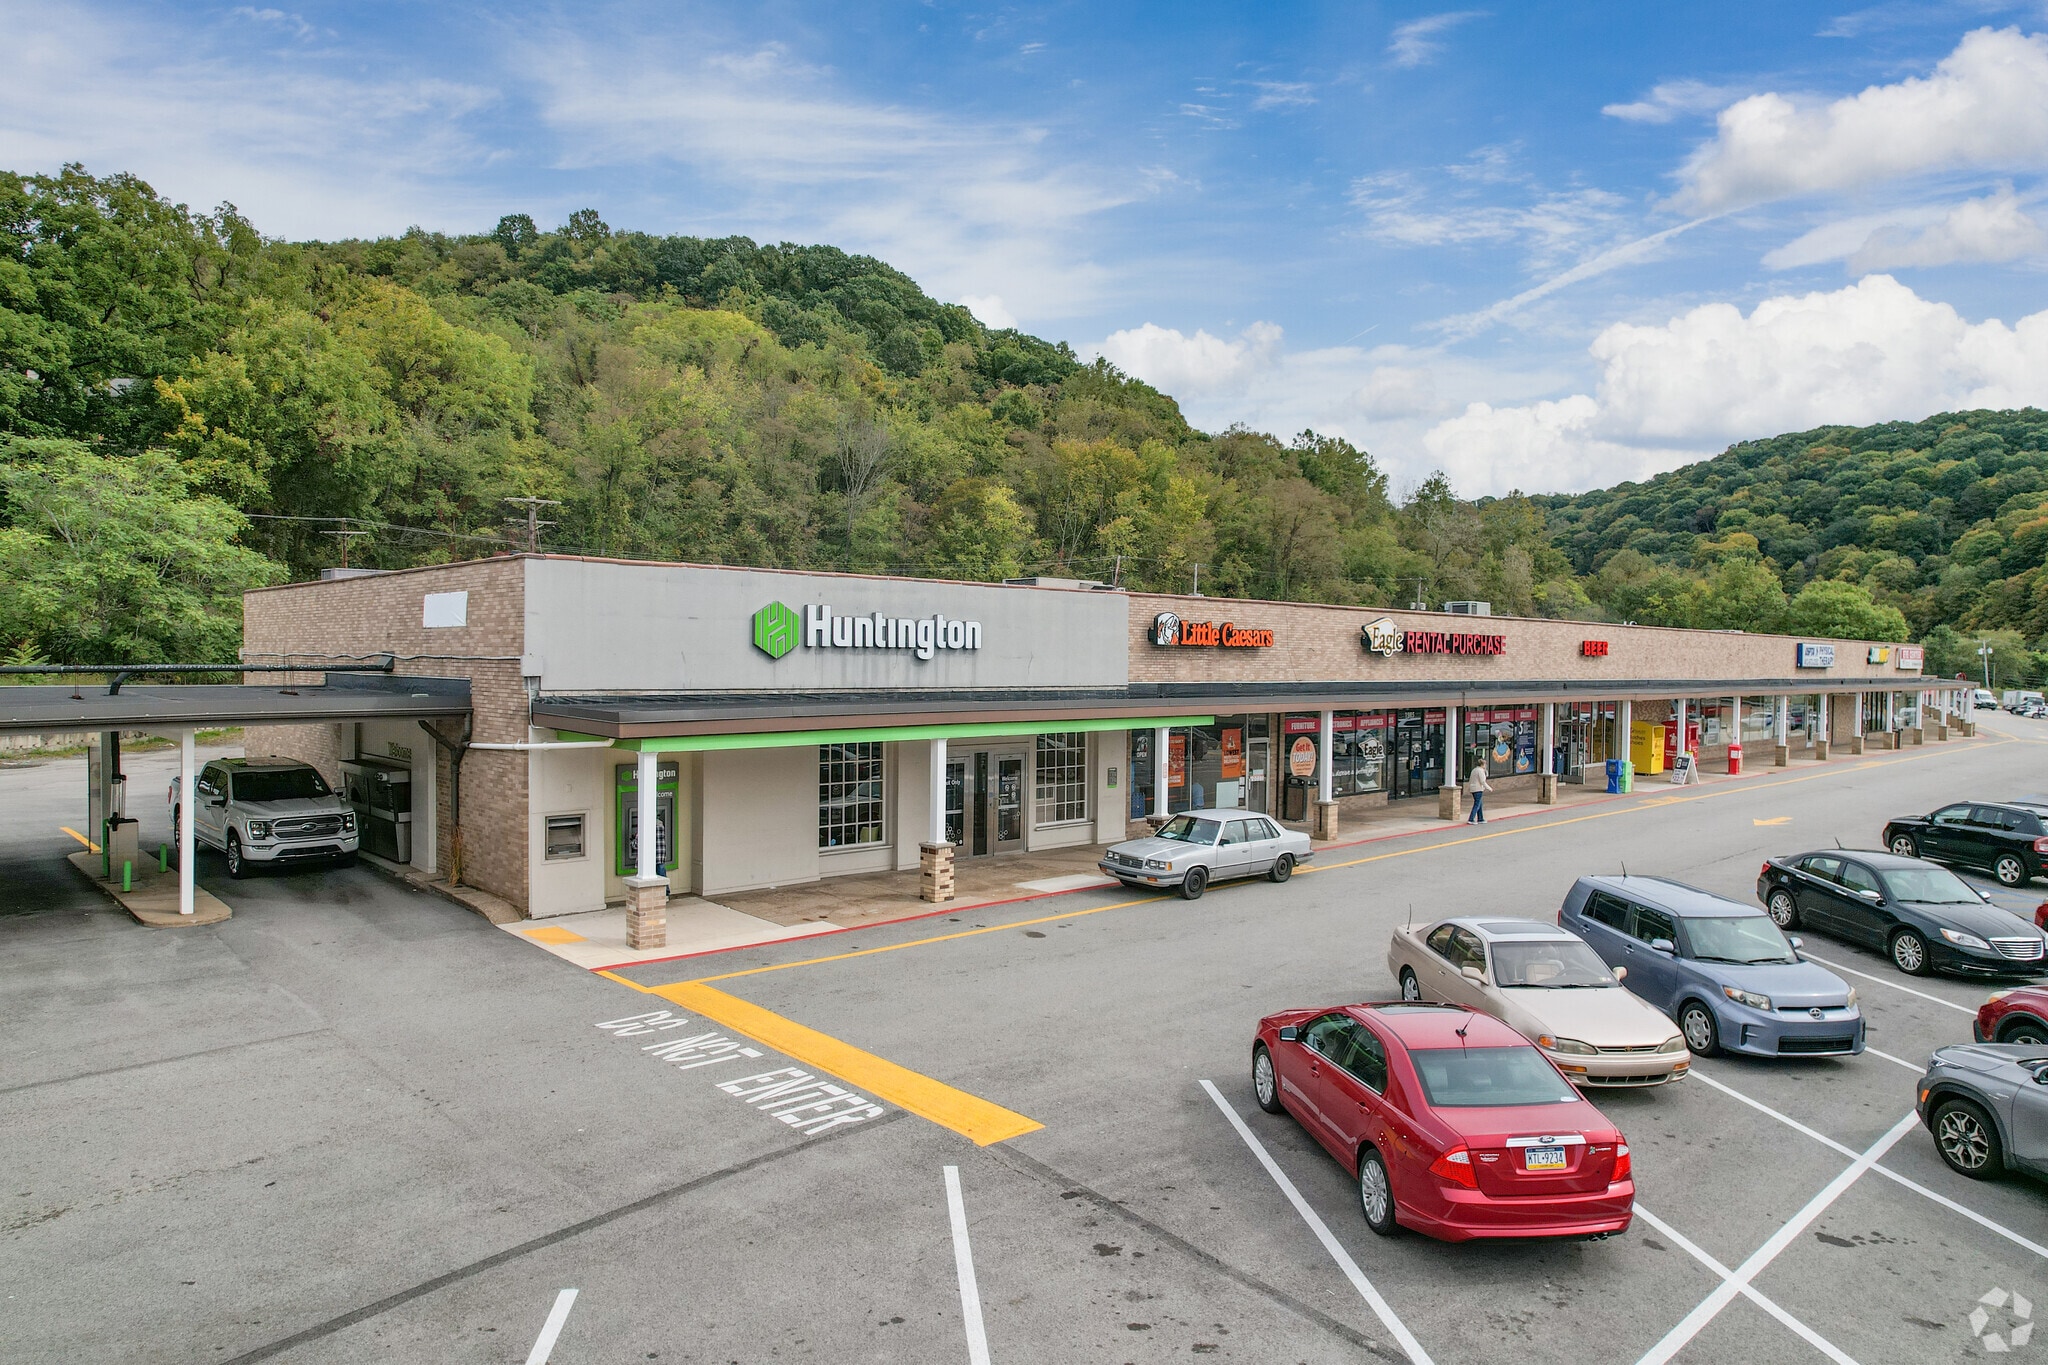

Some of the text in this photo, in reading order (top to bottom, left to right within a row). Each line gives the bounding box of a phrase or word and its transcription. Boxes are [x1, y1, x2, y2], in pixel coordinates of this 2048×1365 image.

[803, 603, 982, 660] Huntington
[1180, 620, 1274, 647] Little Caesars
[1372, 626, 1507, 657] Eagle RENTAL PURCHASE
[1583, 640, 1609, 656] BEER
[1291, 721, 1316, 730] FURNITURE
[1364, 742, 1383, 759] Eagle
[594, 1009, 884, 1136] DO NOT ENTER
